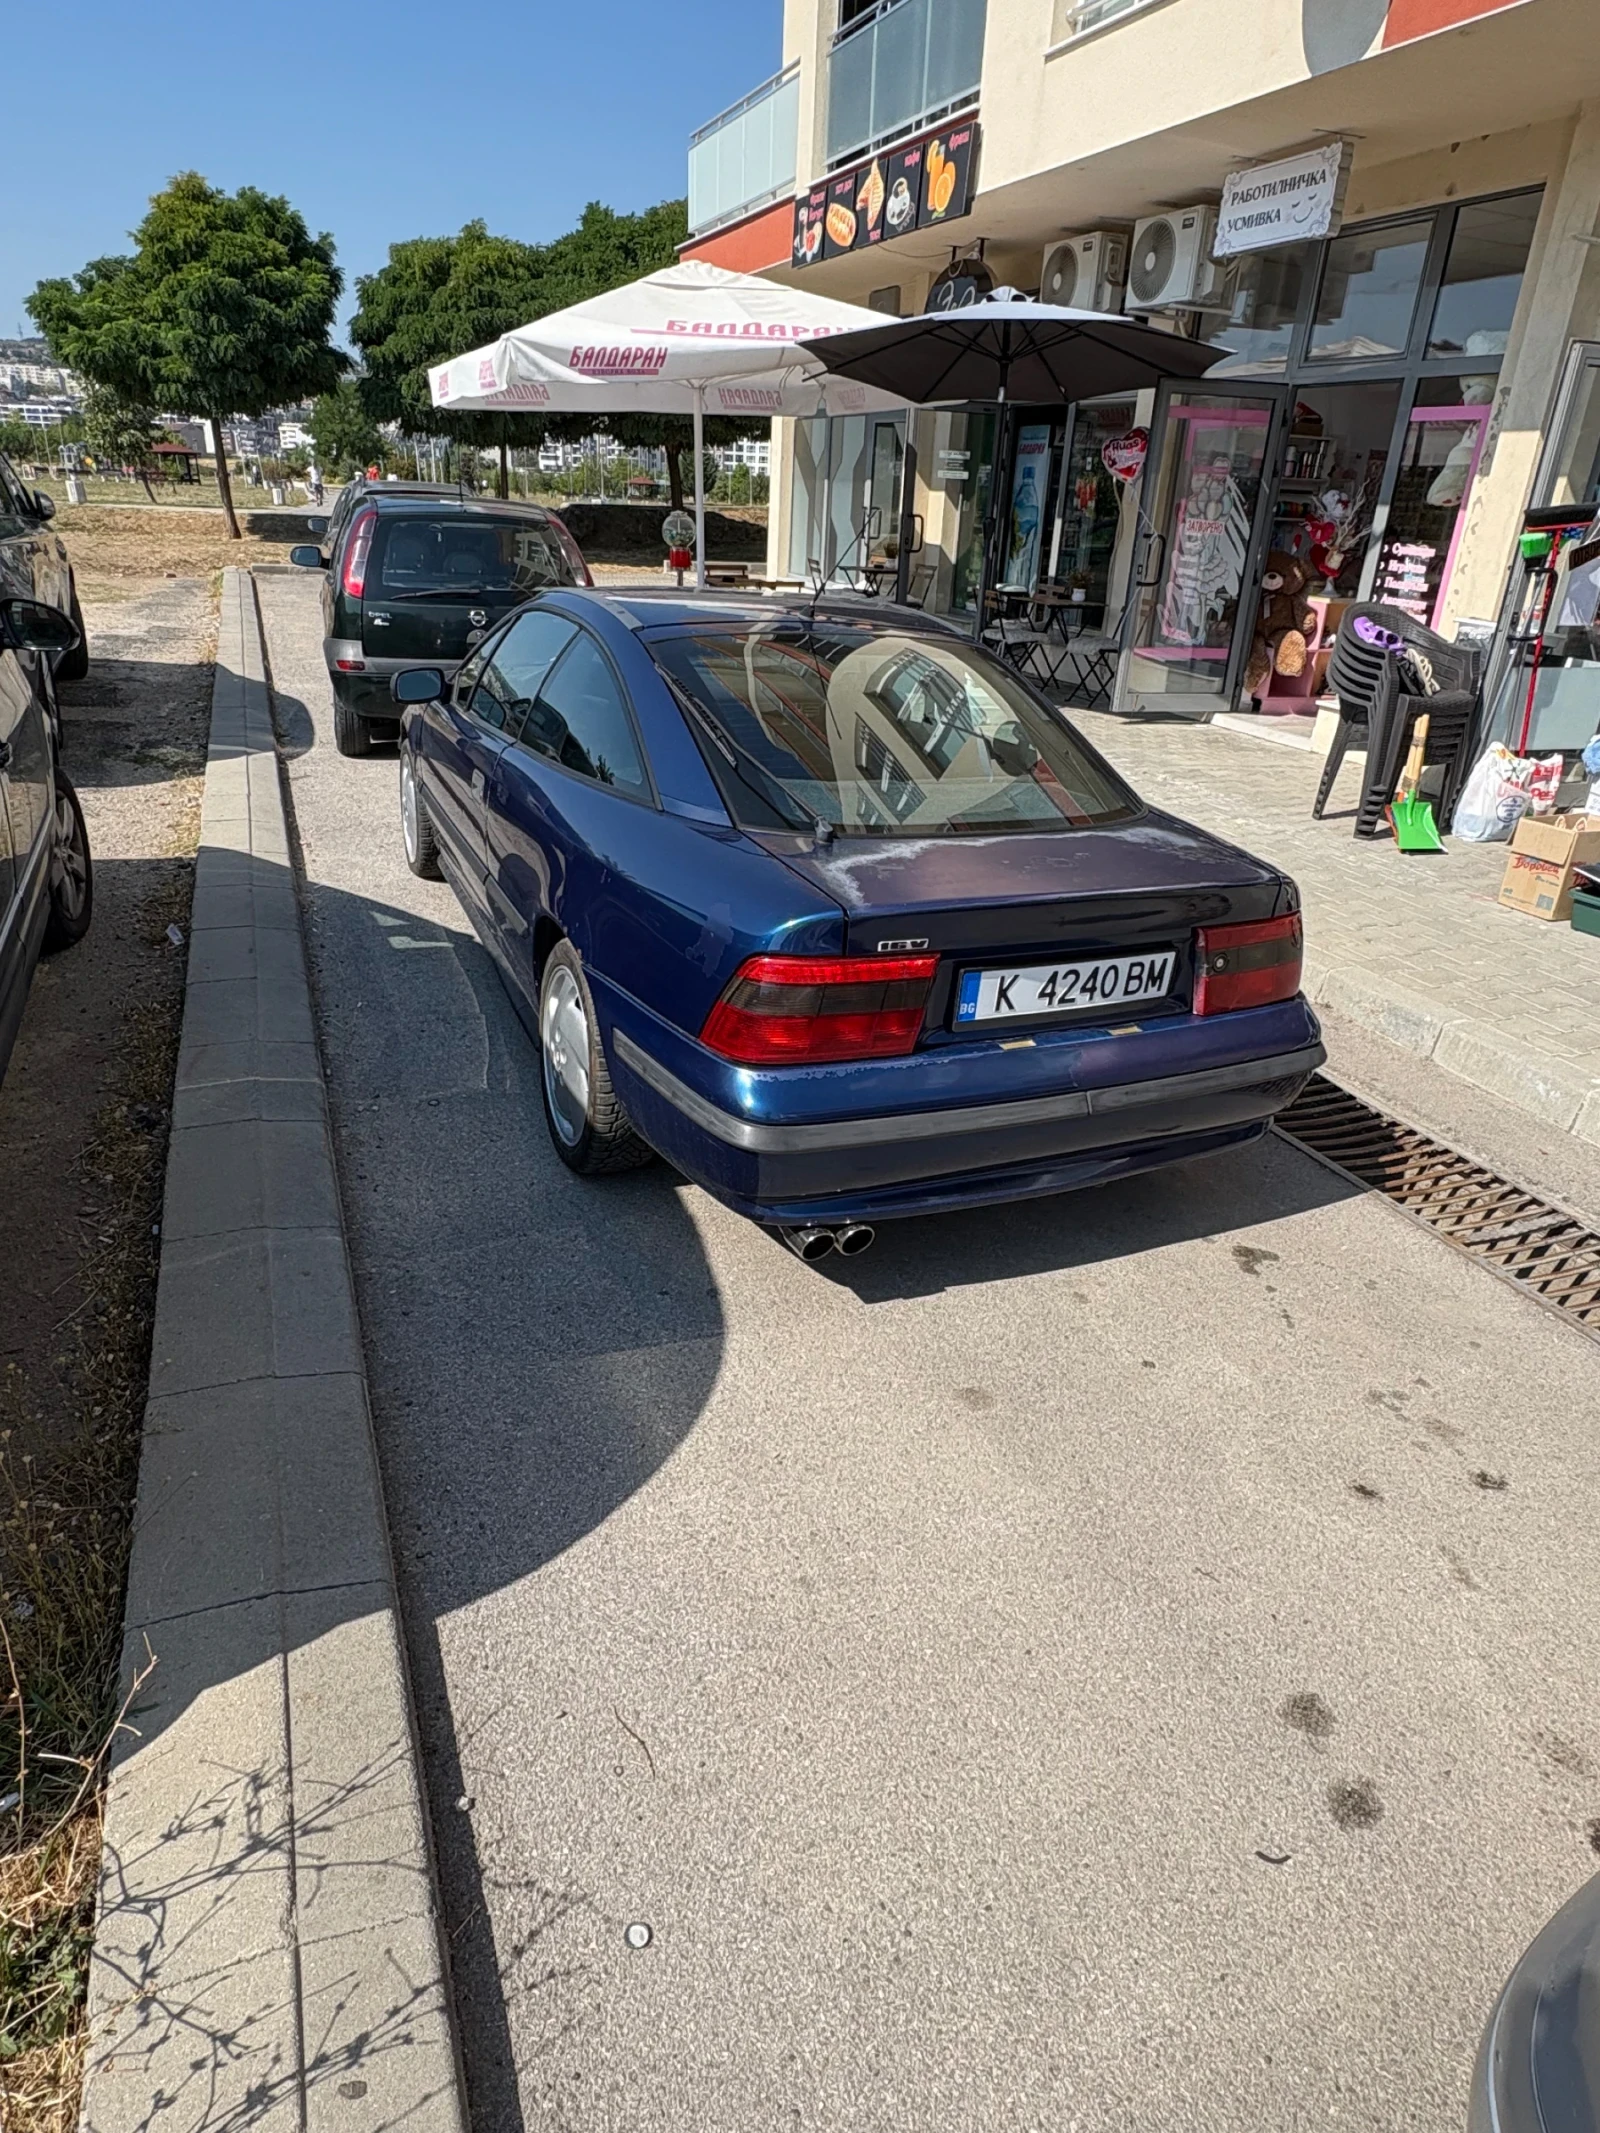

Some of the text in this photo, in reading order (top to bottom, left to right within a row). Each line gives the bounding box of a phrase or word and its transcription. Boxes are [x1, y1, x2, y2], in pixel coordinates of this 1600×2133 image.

[1230, 168, 1327, 206] РАБОТИЛНИЧКА
[1226, 208, 1281, 233] УСМИВКА
[569, 345, 668, 368] БАЛДАРАН
[1186, 519, 1224, 534] ЗАТВОРЕНО
[368, 610, 392, 619] OPEL
[1037, 964, 1119, 1006] 4240
[959, 1002, 976, 1016] BG
